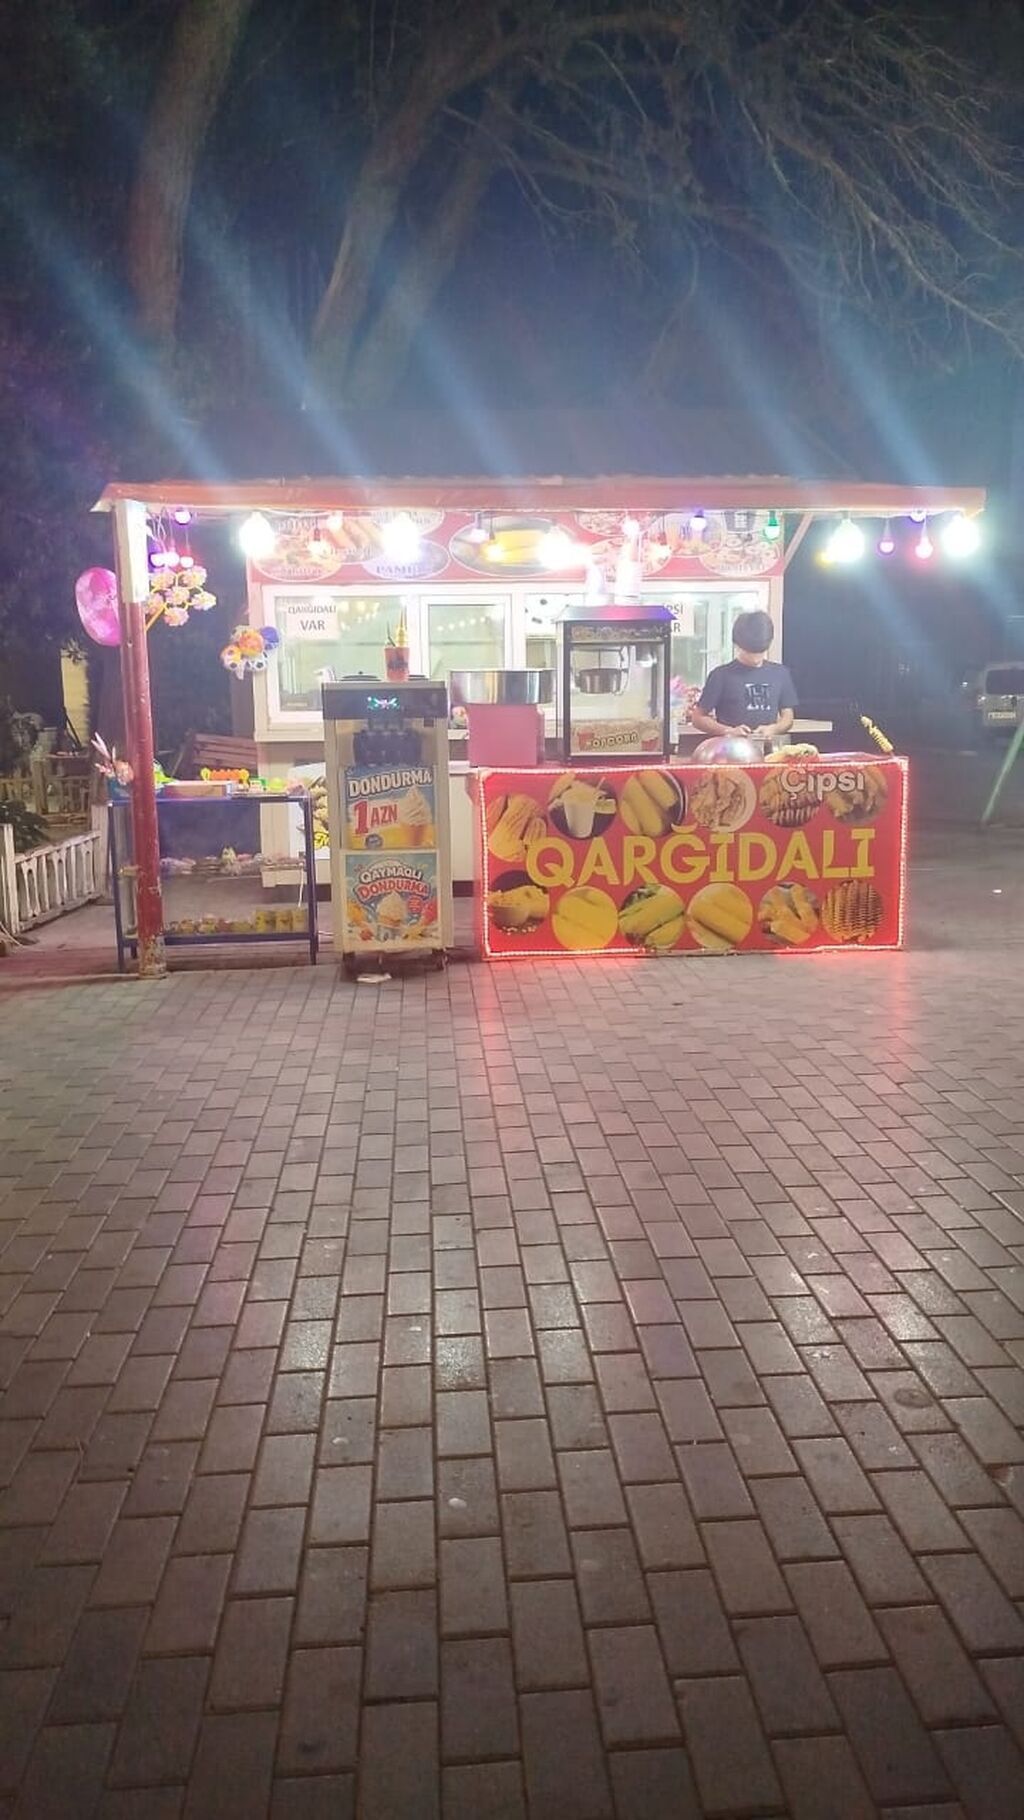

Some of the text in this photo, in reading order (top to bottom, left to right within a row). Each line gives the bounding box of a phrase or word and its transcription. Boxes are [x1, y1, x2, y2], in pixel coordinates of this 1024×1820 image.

[299, 619, 326, 631] VAR
[348, 769, 433, 798] DONDURMA
[780, 766, 865, 801] Çipsi
[354, 800, 398, 834] 1 AZN
[360, 866, 422, 884] QAYMAQLI
[358, 879, 429, 900] DONDURMA
